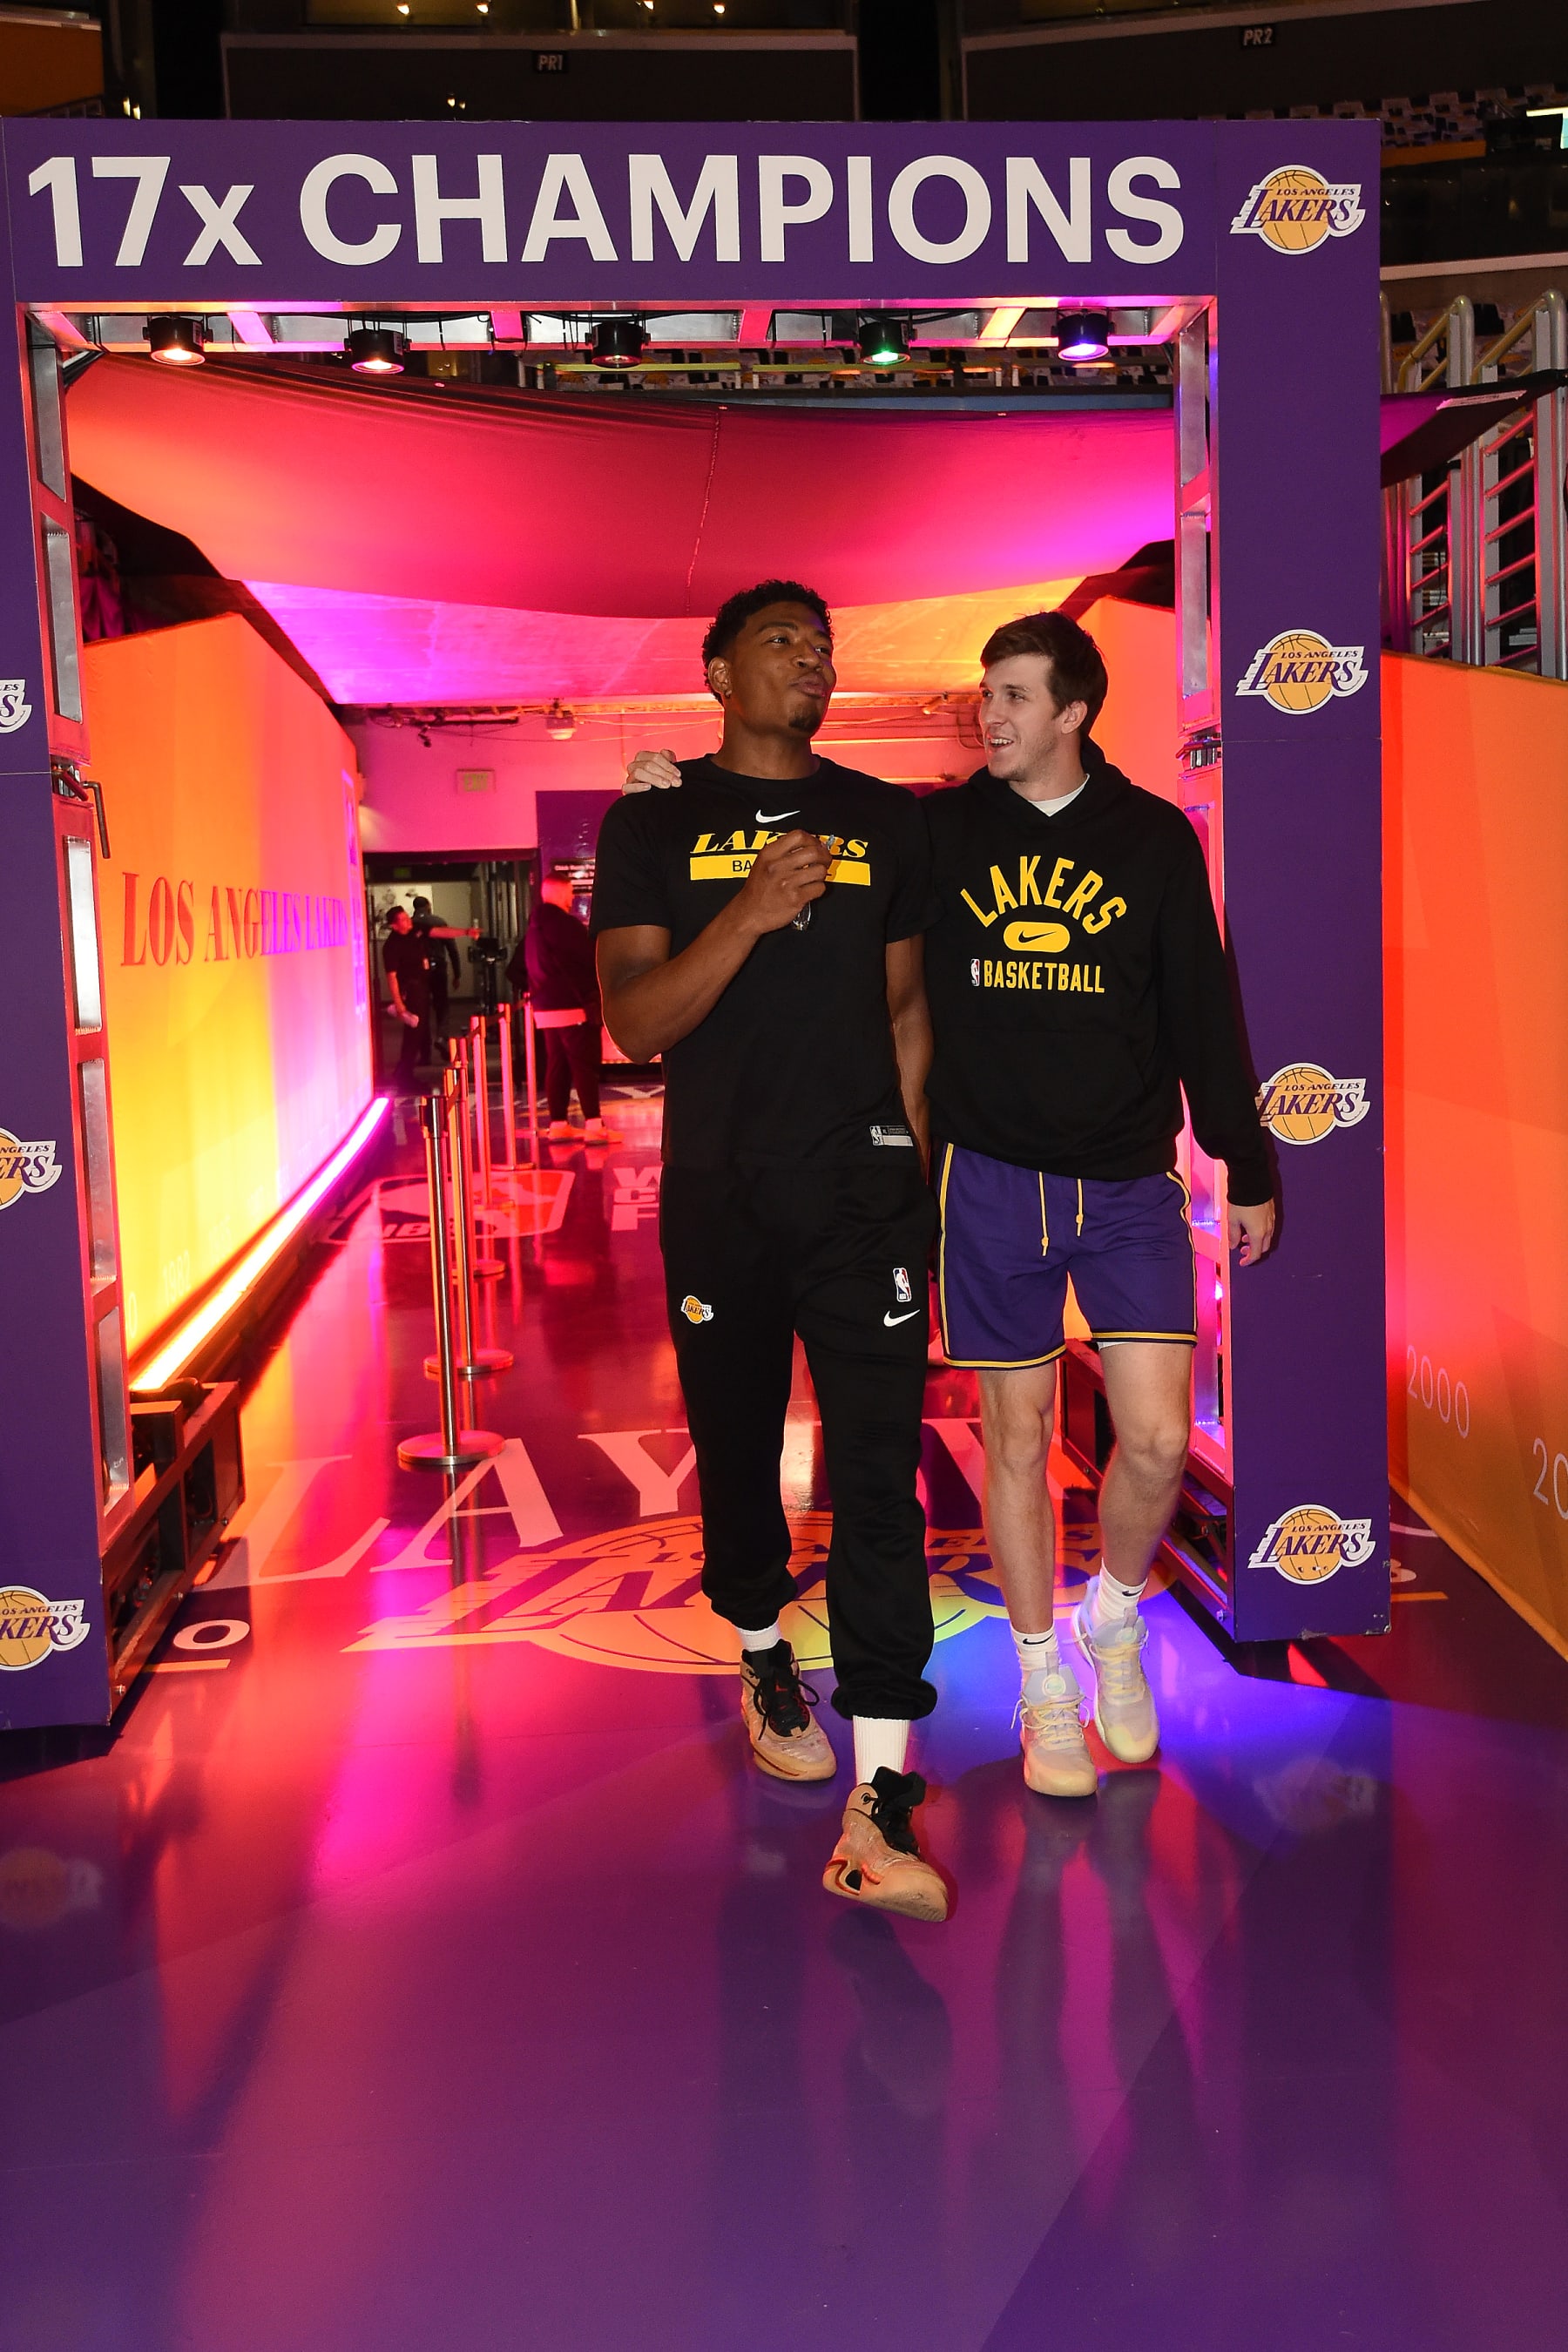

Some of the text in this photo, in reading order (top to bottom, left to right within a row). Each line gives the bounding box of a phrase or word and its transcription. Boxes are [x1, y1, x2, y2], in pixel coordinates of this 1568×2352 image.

[1243, 28, 1272, 45] PR2
[28, 152, 1185, 267] 17x CHAMPIONS
[1238, 188, 1357, 231] LAKERS
[1242, 652, 1360, 692] LAKERS
[1304, 650, 1359, 659] ANGELES
[690, 830, 868, 858] LAKRS
[960, 855, 1127, 934] LAKERS
[120, 871, 195, 967] LOS
[204, 885, 301, 963] ANGELES
[983, 960, 1105, 993] BASKETBALL
[1257, 1085, 1361, 1122] LAKERS
[1307, 1082, 1361, 1091] ANGELES
[0, 1145, 50, 1153] NGELES
[1407, 1344, 1470, 1438] 2000
[1254, 1526, 1367, 1563] LAKERS
[1314, 1523, 1367, 1532] ANGELES
[0, 1604, 78, 1616] OS ANGELES
